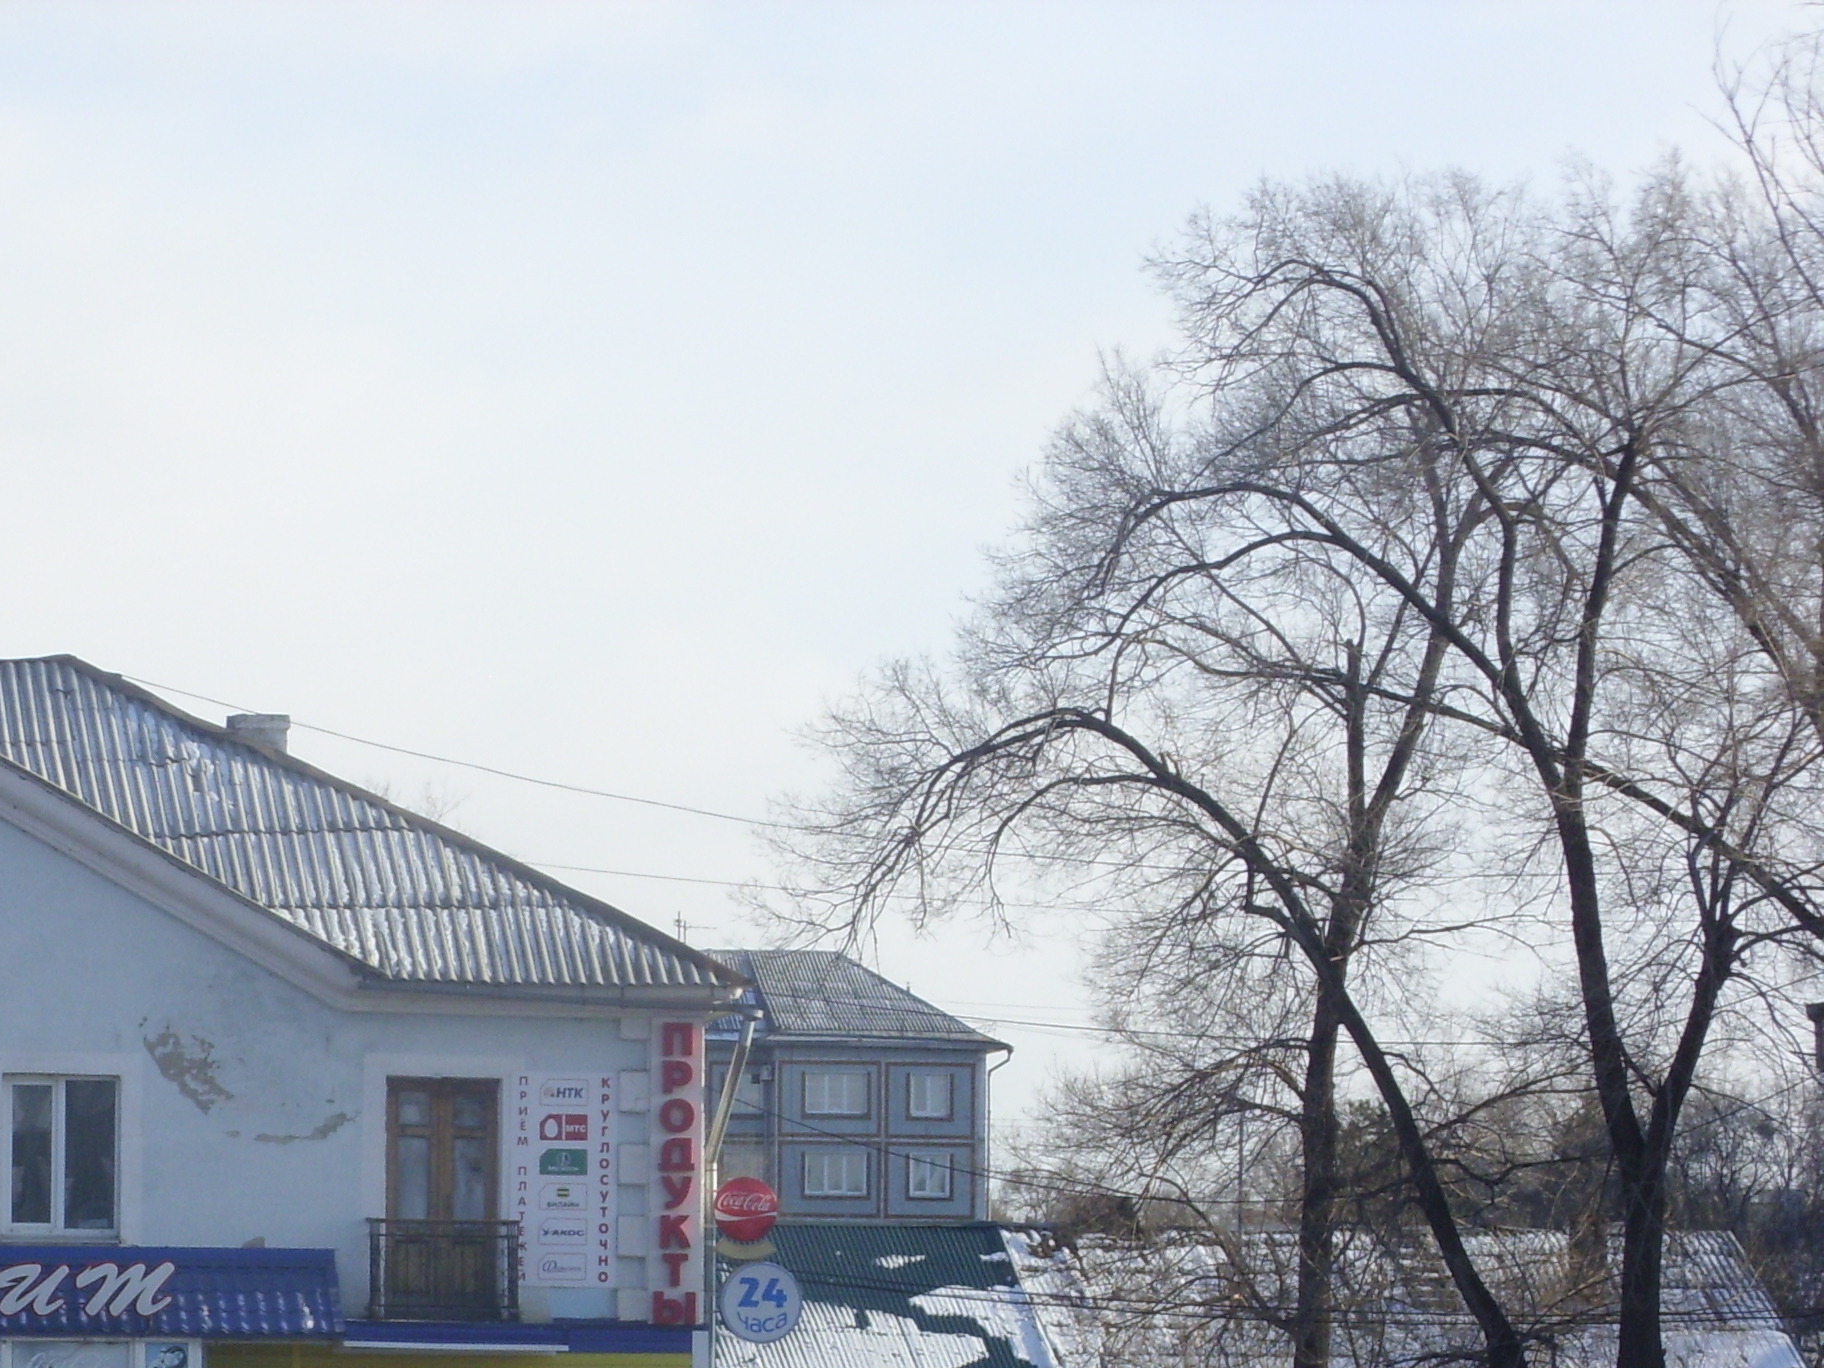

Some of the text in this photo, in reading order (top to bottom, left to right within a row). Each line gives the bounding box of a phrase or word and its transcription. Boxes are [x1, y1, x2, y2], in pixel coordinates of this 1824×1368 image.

[556, 1087, 584, 1099] НТК
[517, 1075, 529, 1147] ПРИЁМ
[565, 1124, 587, 1133] МТС
[597, 1077, 611, 1284] КРУГЛОСУТОЧНО
[652, 1021, 697, 1326] ПРОДУКТЫ
[737, 1276, 788, 1308] 24
[736, 1311, 788, 1333] часа
